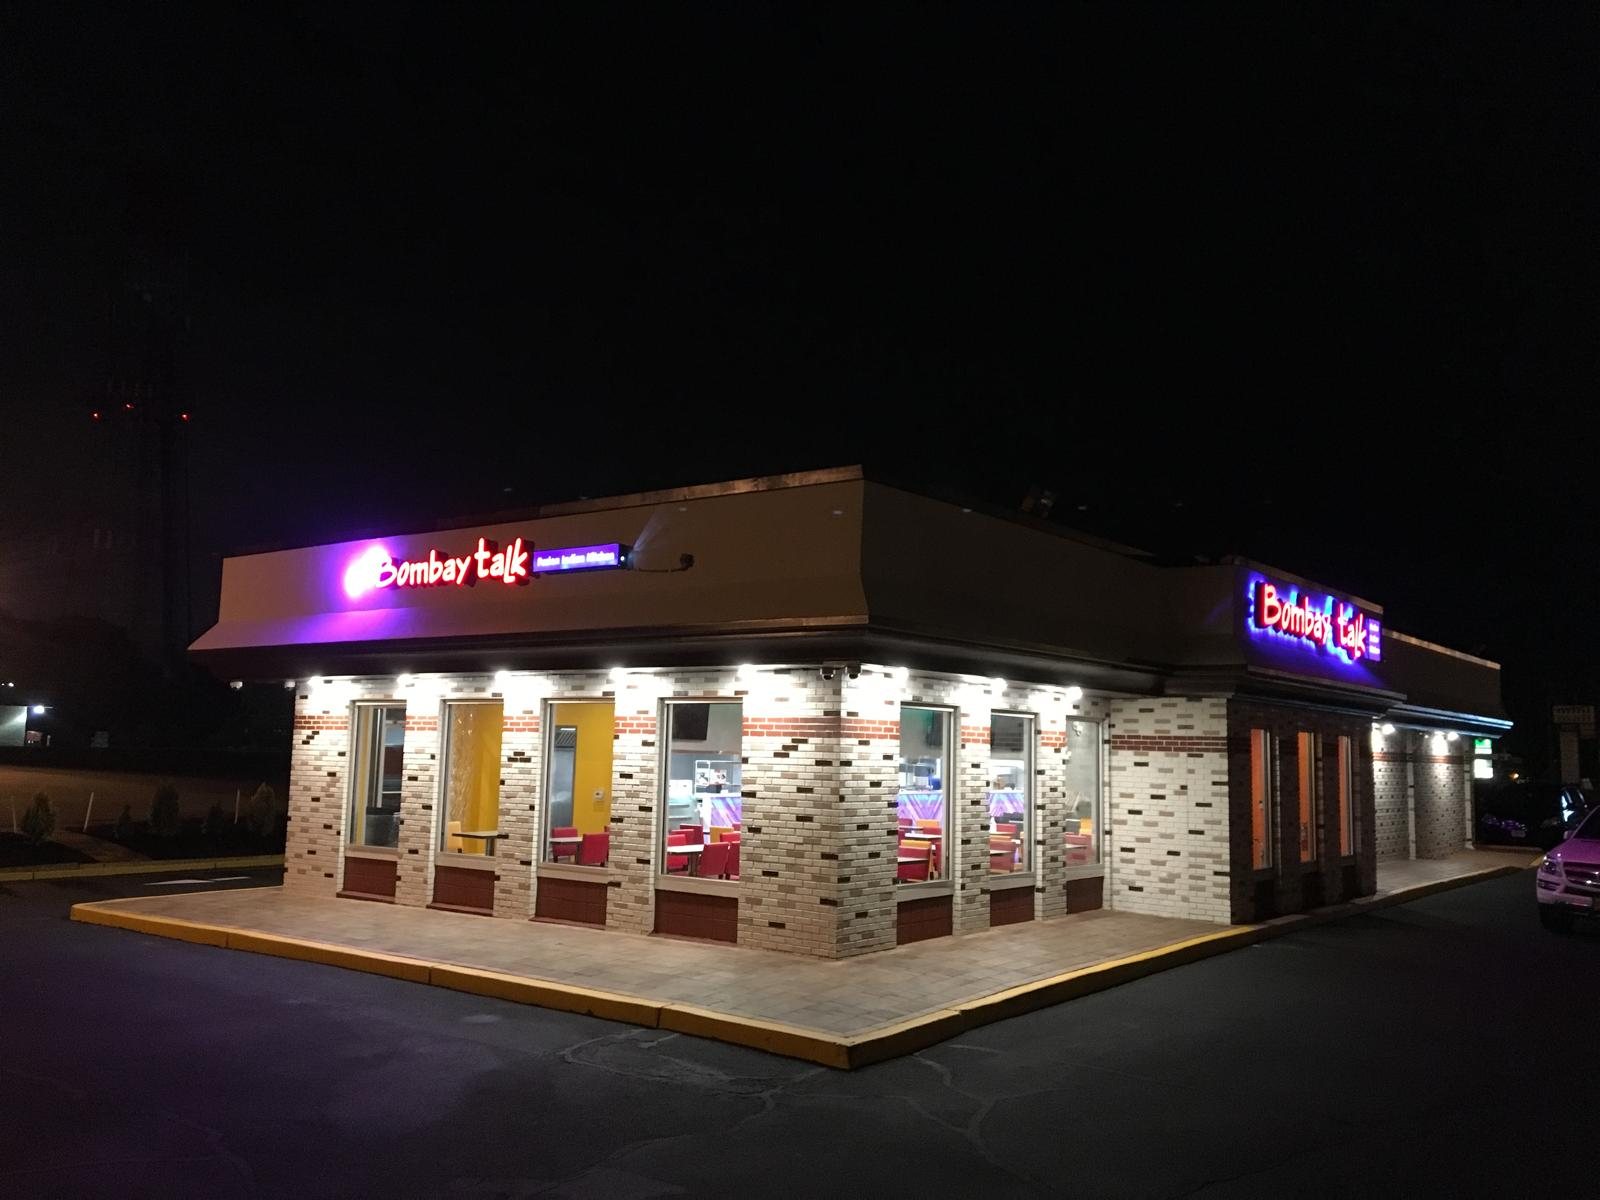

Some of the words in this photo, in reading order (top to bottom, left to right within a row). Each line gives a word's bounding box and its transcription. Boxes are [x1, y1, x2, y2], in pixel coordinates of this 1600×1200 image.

[375, 547, 471, 588] Bombay
[474, 537, 528, 583] talk
[1263, 583, 1332, 645] Bombay
[1337, 602, 1368, 658] talk
